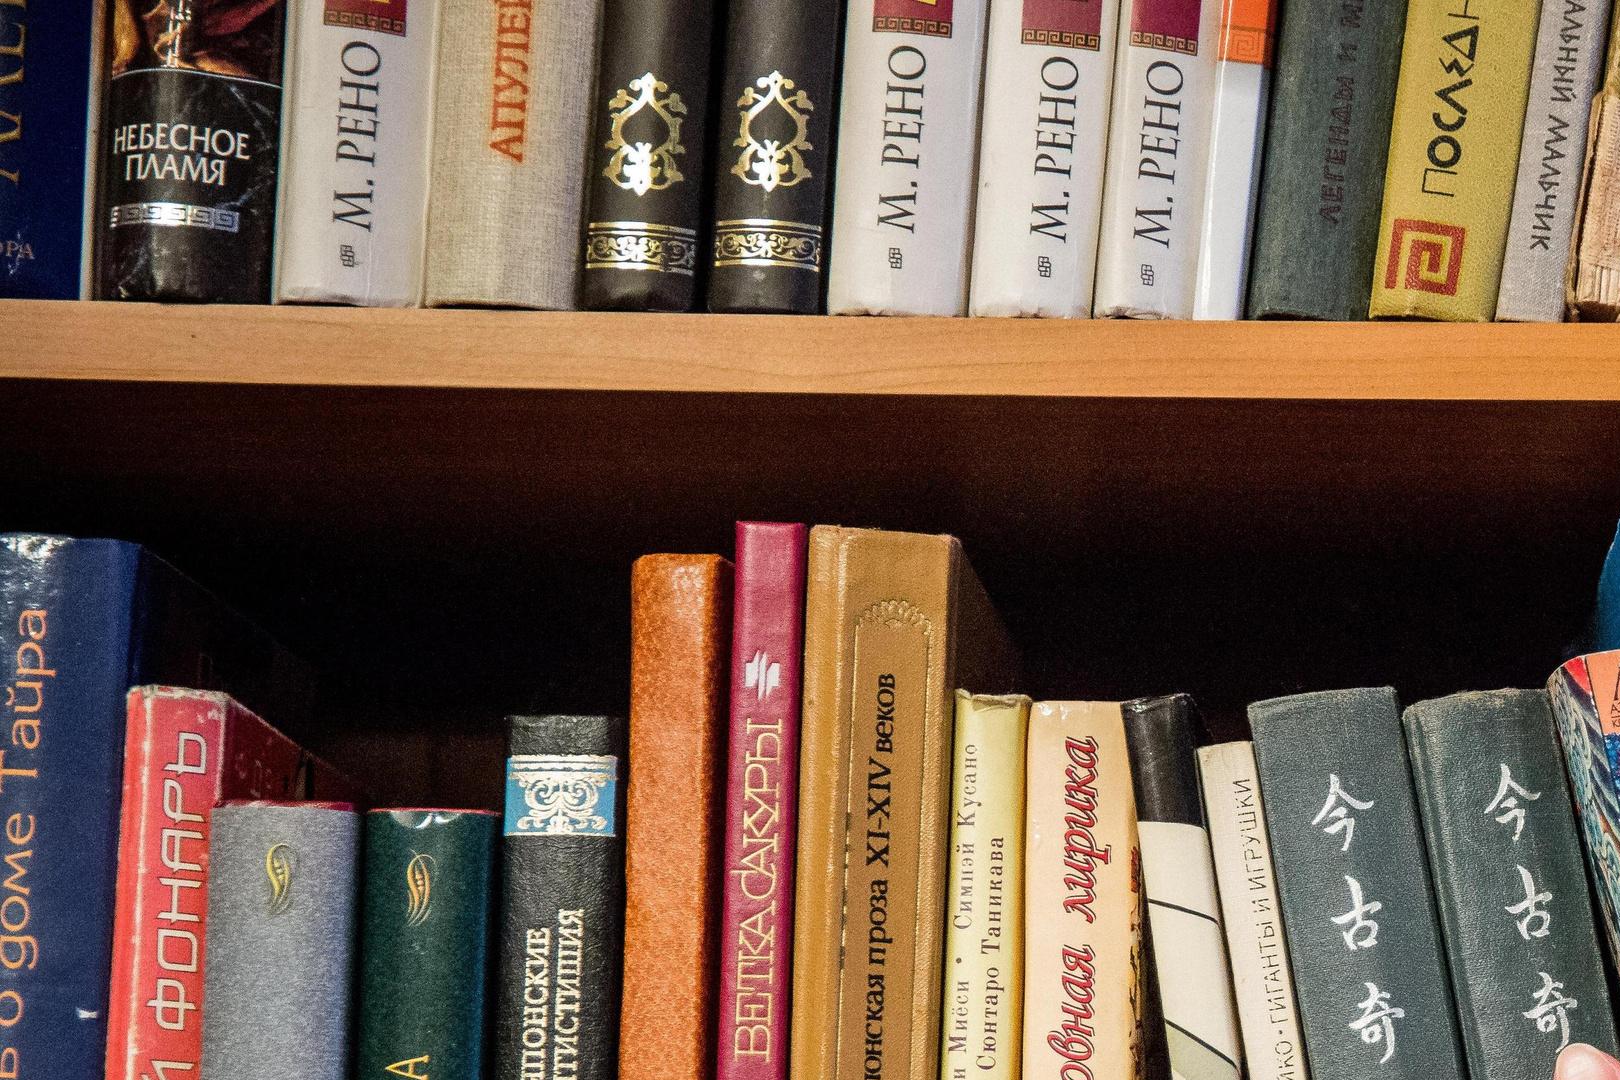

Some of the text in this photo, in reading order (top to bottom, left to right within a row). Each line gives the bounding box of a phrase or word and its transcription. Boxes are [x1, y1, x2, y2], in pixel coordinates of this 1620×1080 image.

[332, 40, 383, 233] М. РЕНО
[489, 0, 533, 163] АПУЛЕ
[876, 45, 927, 235] М. РЕНО
[114, 123, 251, 161] НЕБЕСНОЕ
[125, 154, 227, 187] ПЛАМЯ
[1028, 56, 1079, 244] М. РЕНО
[1132, 60, 1184, 249] М. РЕНО
[1320, 76, 1355, 225] ЛЕГЕНДЫ
[1530, 114, 1570, 250] МАЛЬЧИК
[0, 608, 57, 797] Тайра
[875, 672, 896, 755] веков
[956, 743, 982, 829] Кусано
[1063, 736, 1112, 925] лирика
[1233, 776, 1269, 892] ИГРУШКИ
[147, 730, 208, 1030] ФОНАРЬ
[731, 717, 783, 1063] ВЕТКА САКУРЫ
[866, 879, 896, 966] проза
[952, 843, 976, 930] Симпэй
[980, 836, 1005, 954] Таникава
[1257, 897, 1271, 915] И
[948, 979, 970, 1053] Миёси
[976, 958, 1003, 1071] Сюнтаро
[1257, 919, 1290, 1025] ГИГАНТЫ
